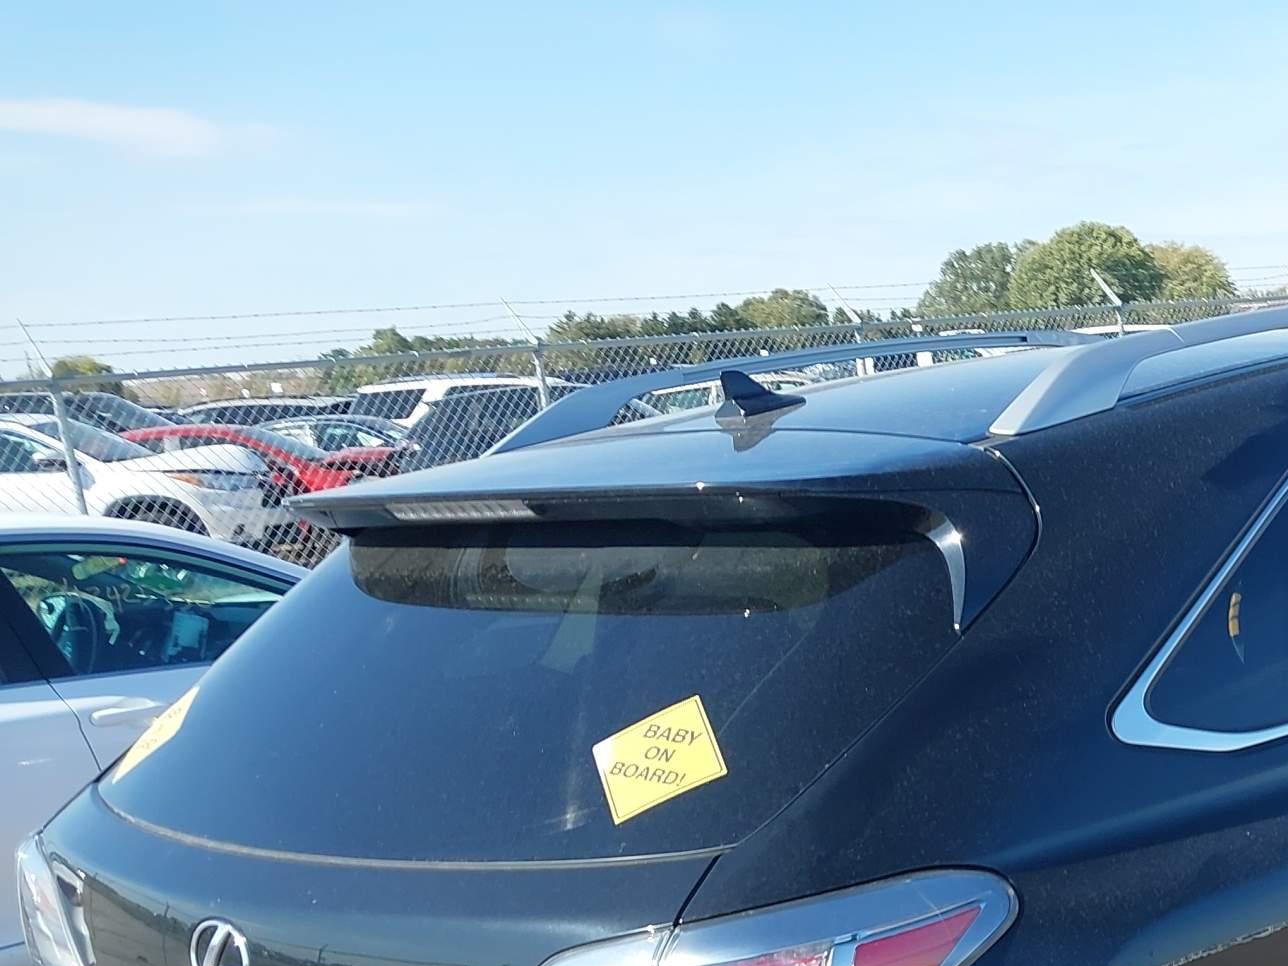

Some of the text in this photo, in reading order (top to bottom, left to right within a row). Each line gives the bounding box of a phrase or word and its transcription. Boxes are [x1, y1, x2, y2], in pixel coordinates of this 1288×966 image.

[643, 724, 702, 746] BABY
[644, 745, 676, 763] ON
[609, 761, 686, 787] BOARD!
